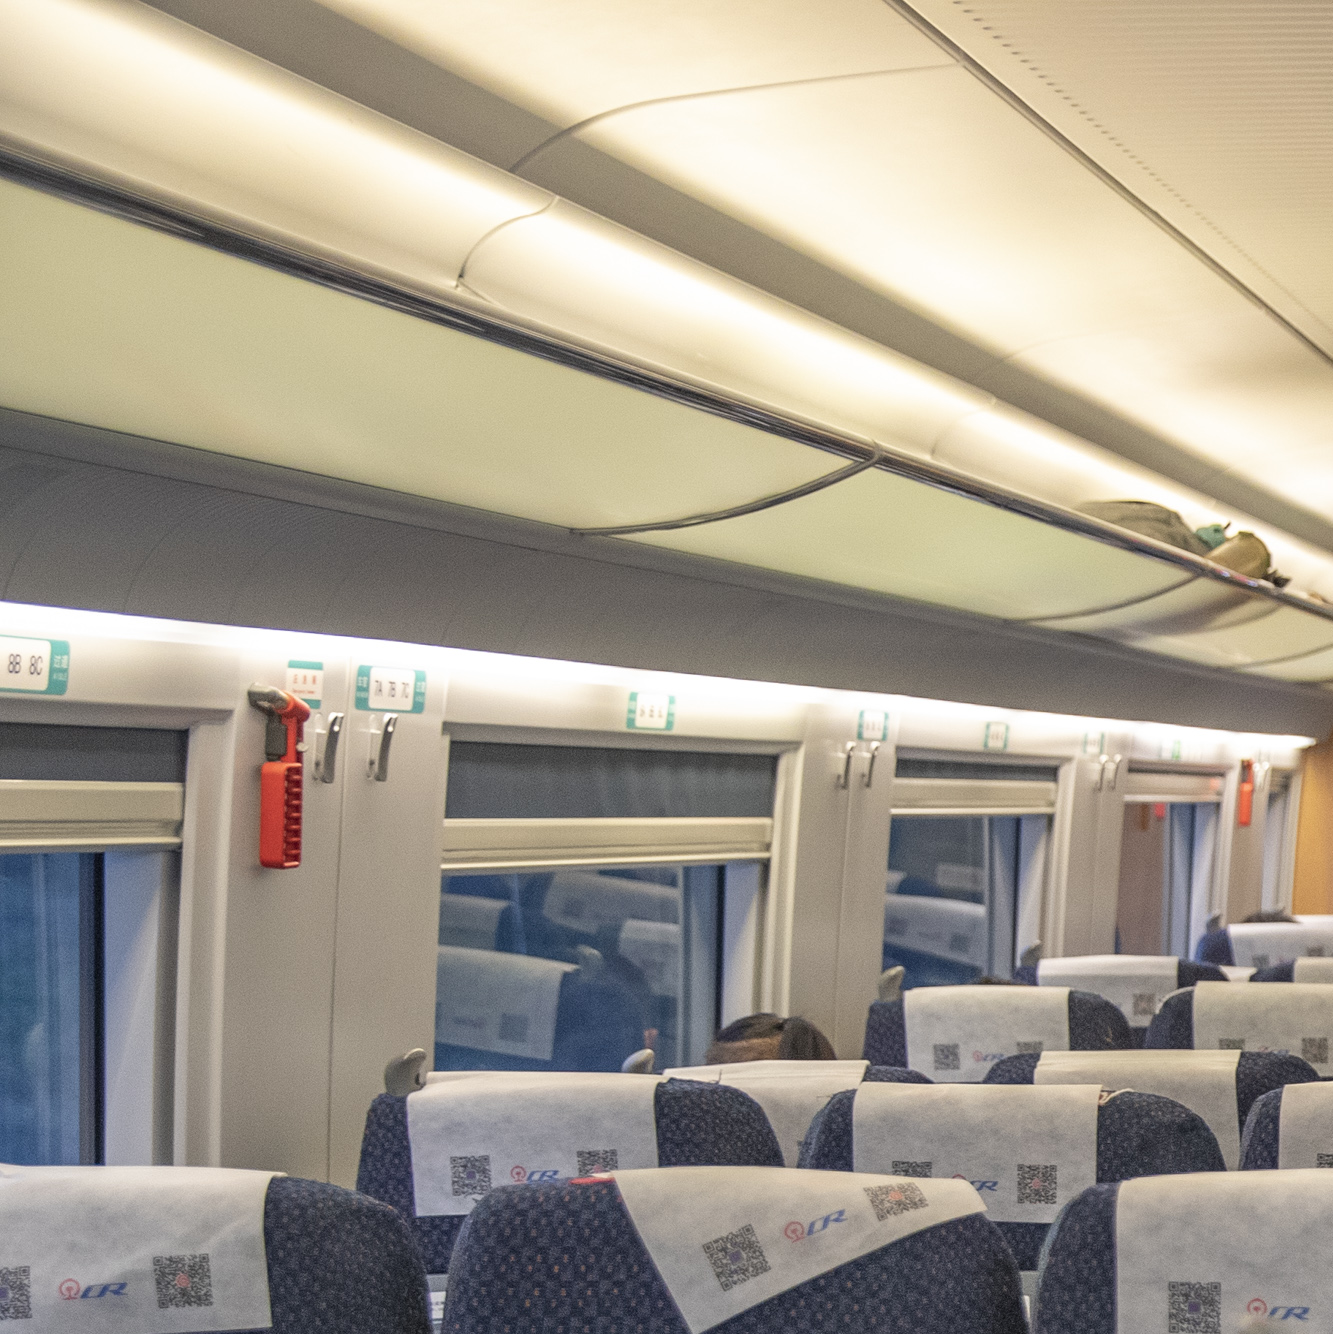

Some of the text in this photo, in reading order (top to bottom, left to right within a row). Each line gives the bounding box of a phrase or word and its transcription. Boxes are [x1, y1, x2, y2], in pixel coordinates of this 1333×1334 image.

[8, 653, 44, 676] 8B 8C
[806, 1208, 846, 1237] CR
[80, 1282, 128, 1299] CR
[1269, 1306, 1310, 1320] CR
